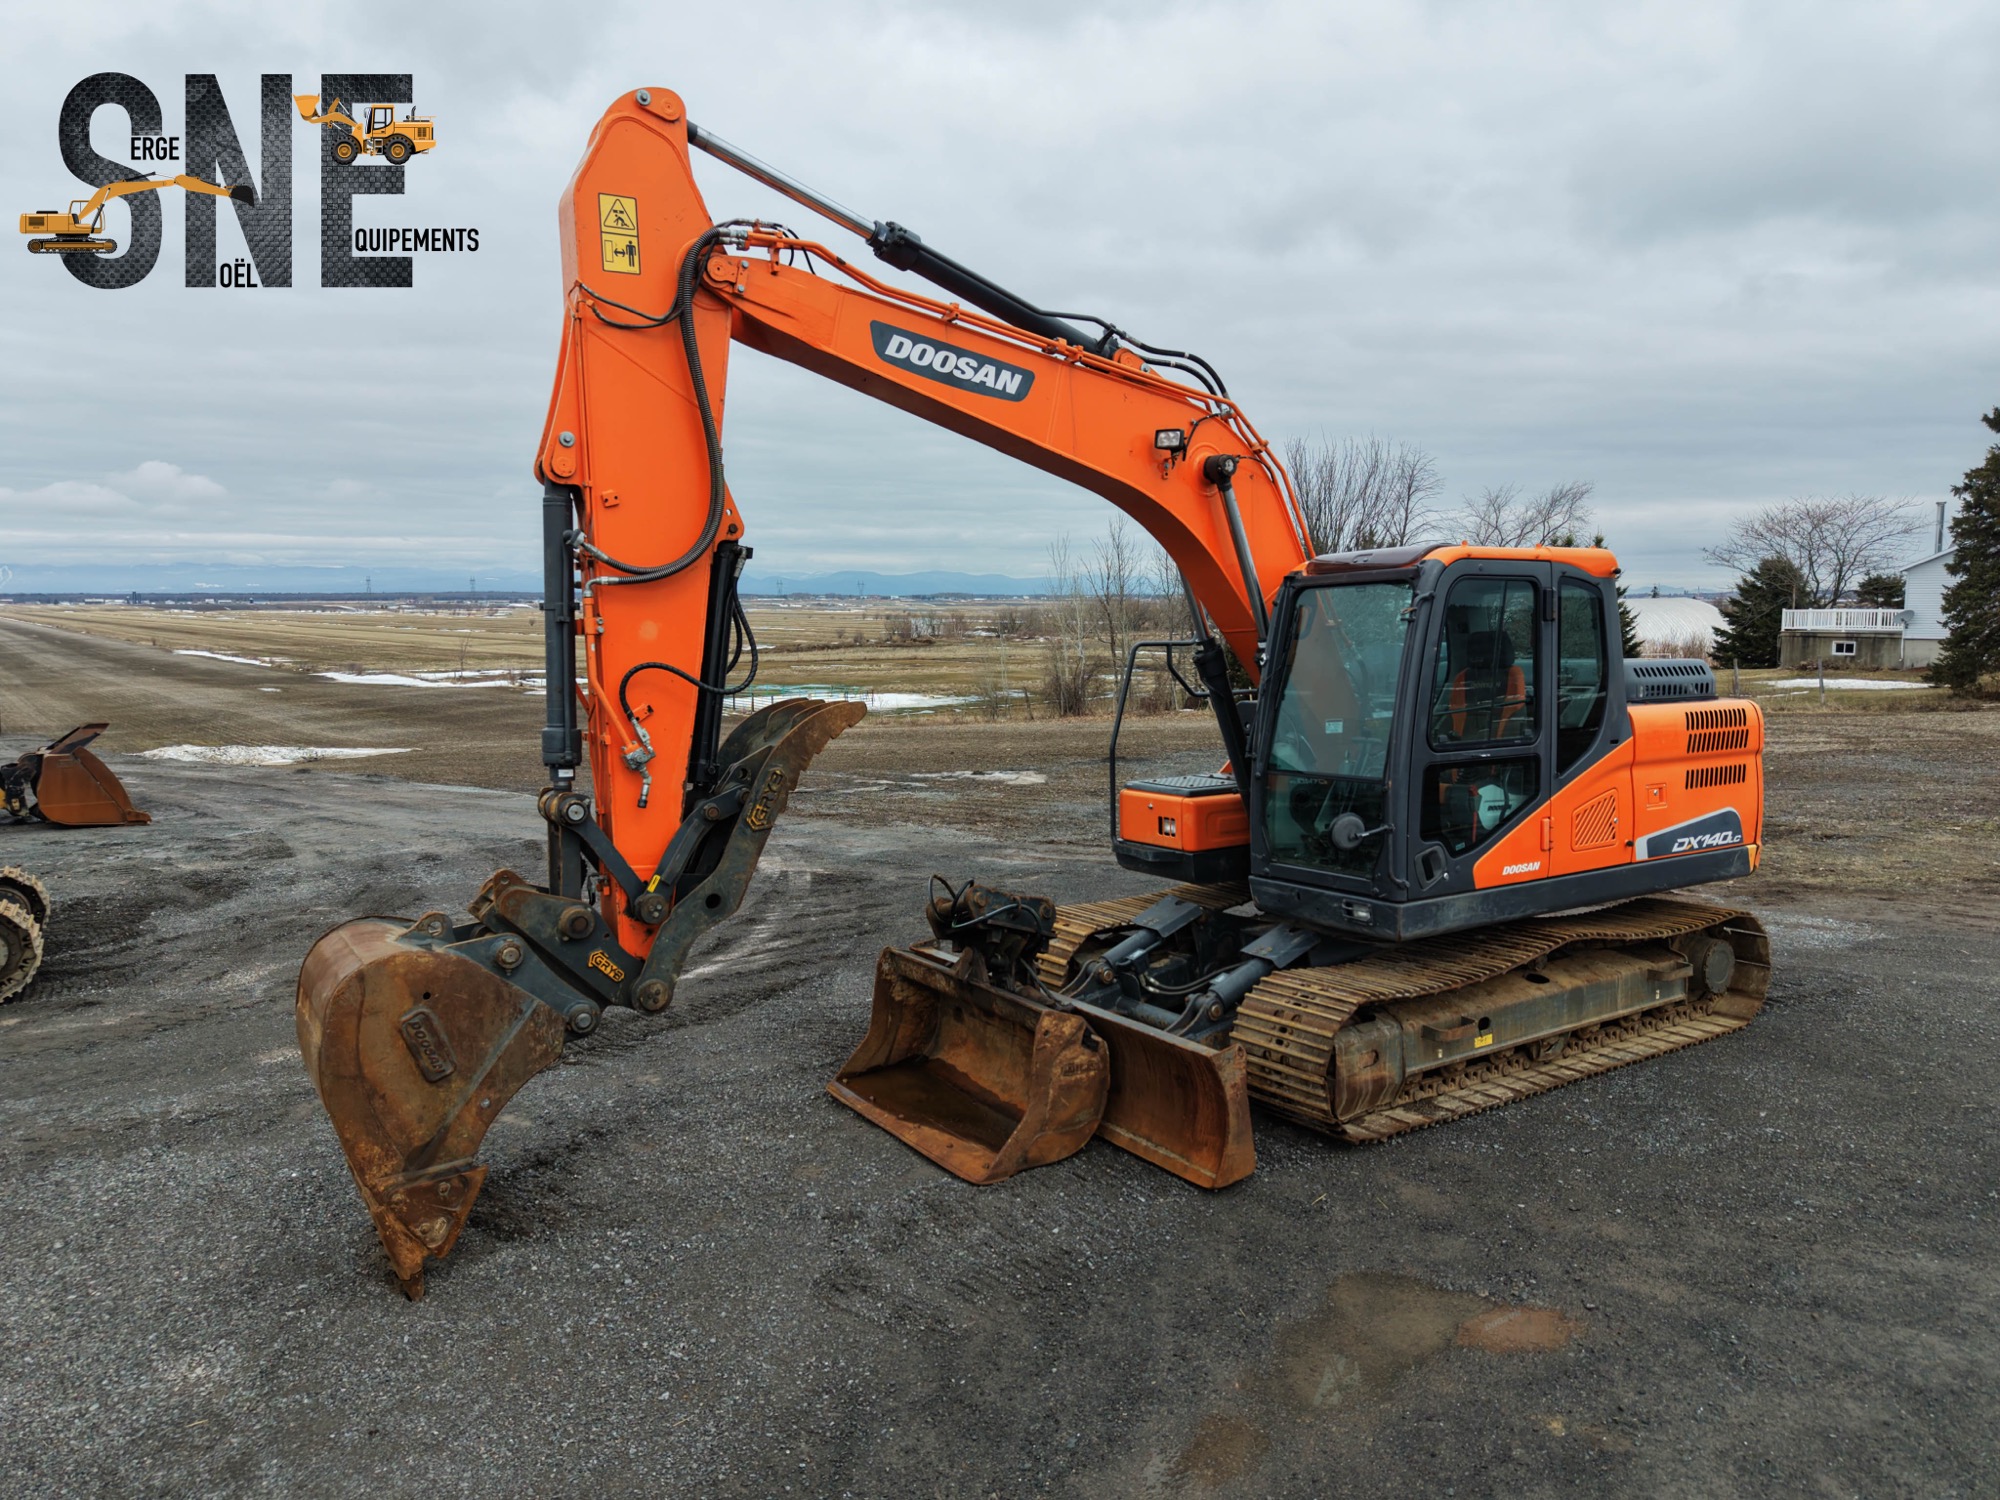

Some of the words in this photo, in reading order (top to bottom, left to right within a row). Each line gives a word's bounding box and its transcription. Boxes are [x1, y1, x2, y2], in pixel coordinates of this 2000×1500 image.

[885, 334, 1023, 395] DOOSAN
[1502, 861, 1541, 876] DOOSAN
[590, 952, 625, 982] GRYB
[405, 1021, 446, 1073] DOOSAN
